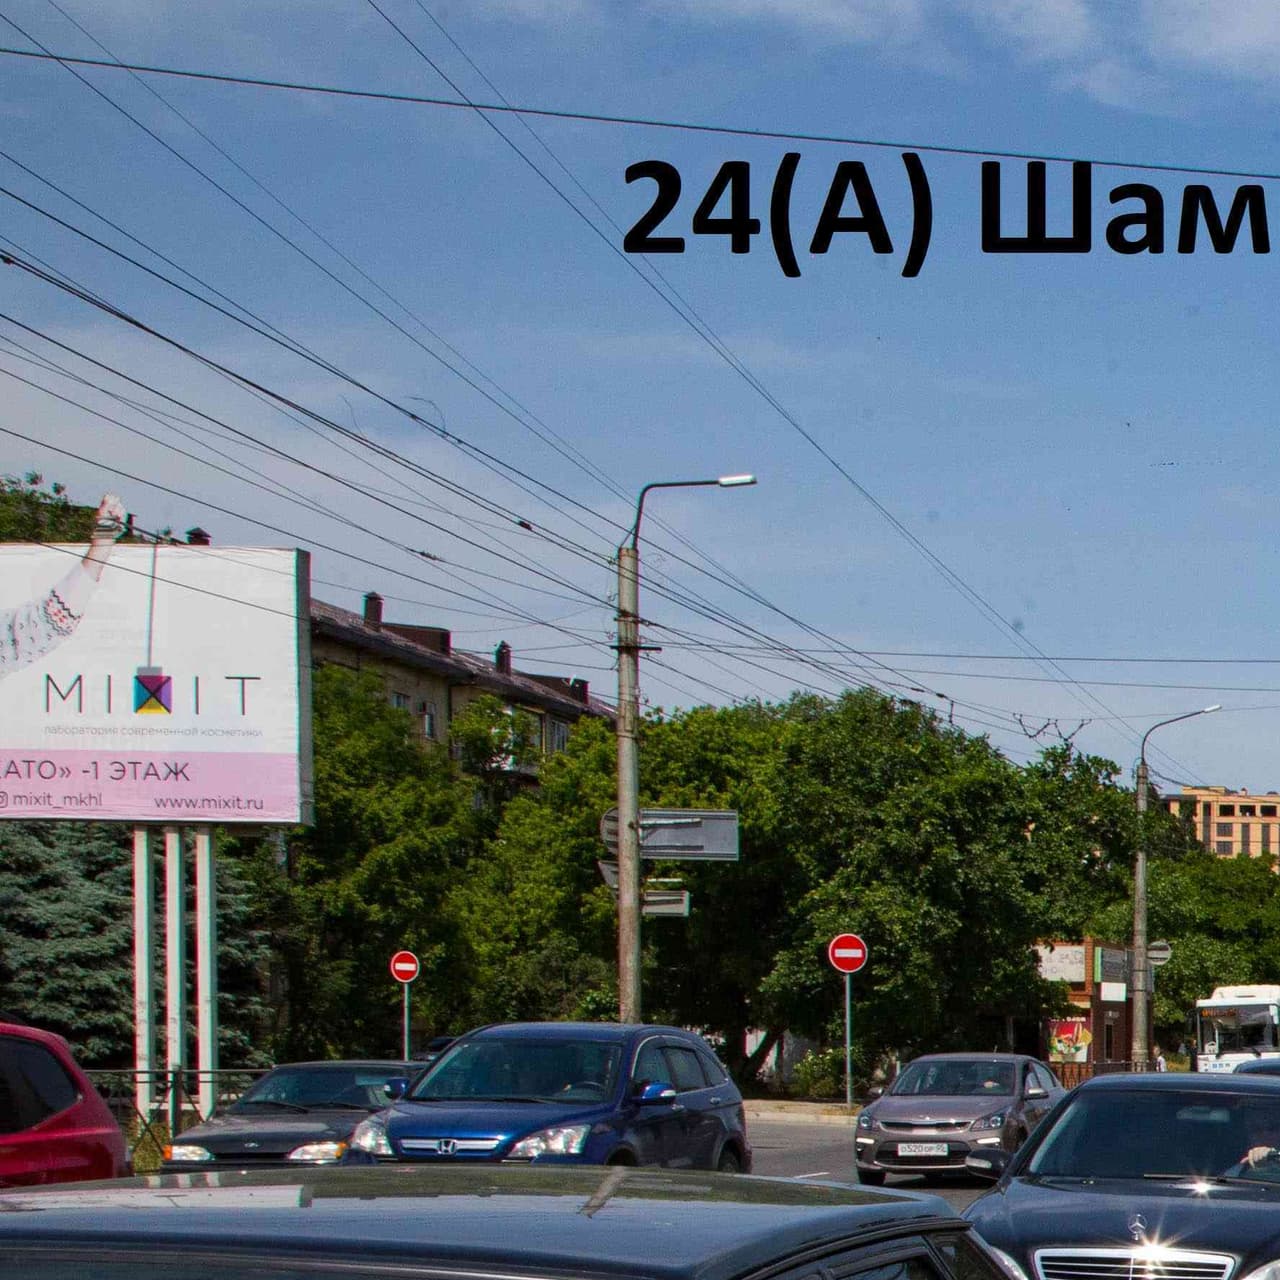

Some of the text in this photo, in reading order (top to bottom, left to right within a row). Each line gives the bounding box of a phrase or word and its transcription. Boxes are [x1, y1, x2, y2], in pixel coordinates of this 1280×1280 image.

[45, 674, 261, 715] MIXIT
[0, 760, 191, 781] АТО» -1 ЭТАЖ
[13, 792, 103, 809] mixit_mkhl
[154, 797, 264, 811] www.mixit.ru
